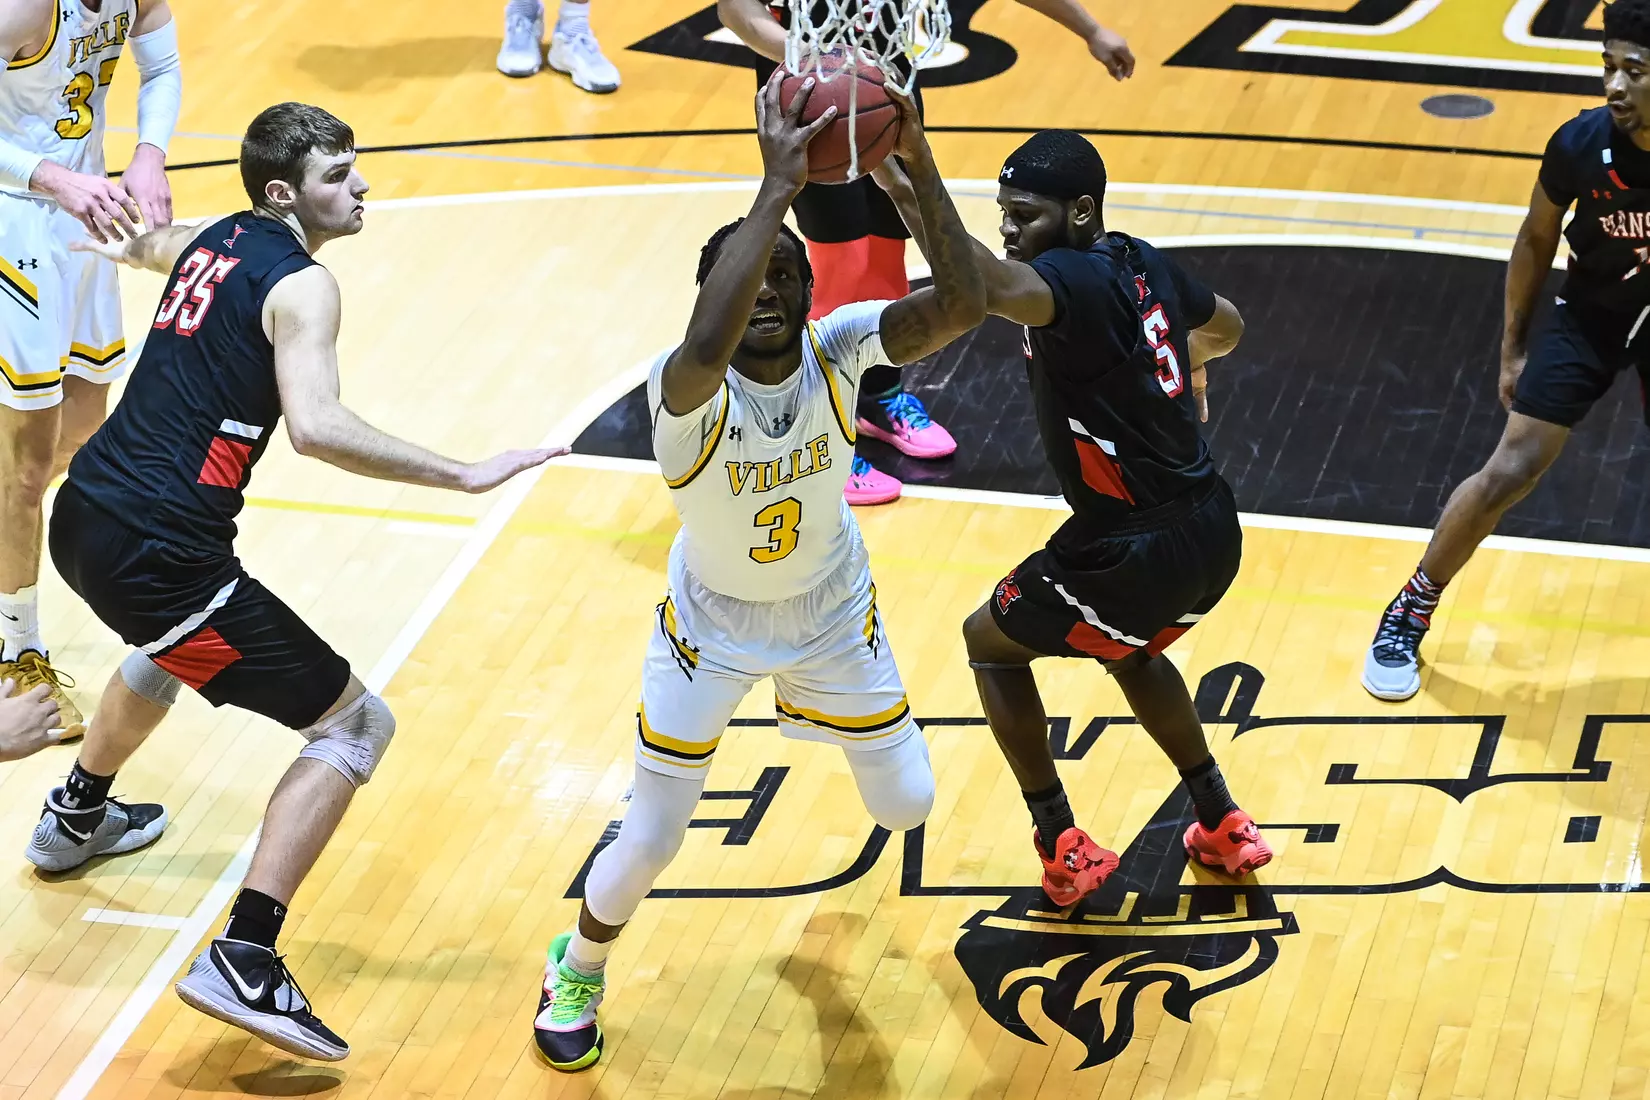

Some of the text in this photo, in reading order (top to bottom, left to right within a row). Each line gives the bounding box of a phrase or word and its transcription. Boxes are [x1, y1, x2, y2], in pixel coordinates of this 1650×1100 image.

[153, 247, 241, 337] 35
[1141, 303, 1184, 399] 5
[725, 433, 832, 496] VILLE
[749, 496, 802, 564] 3
